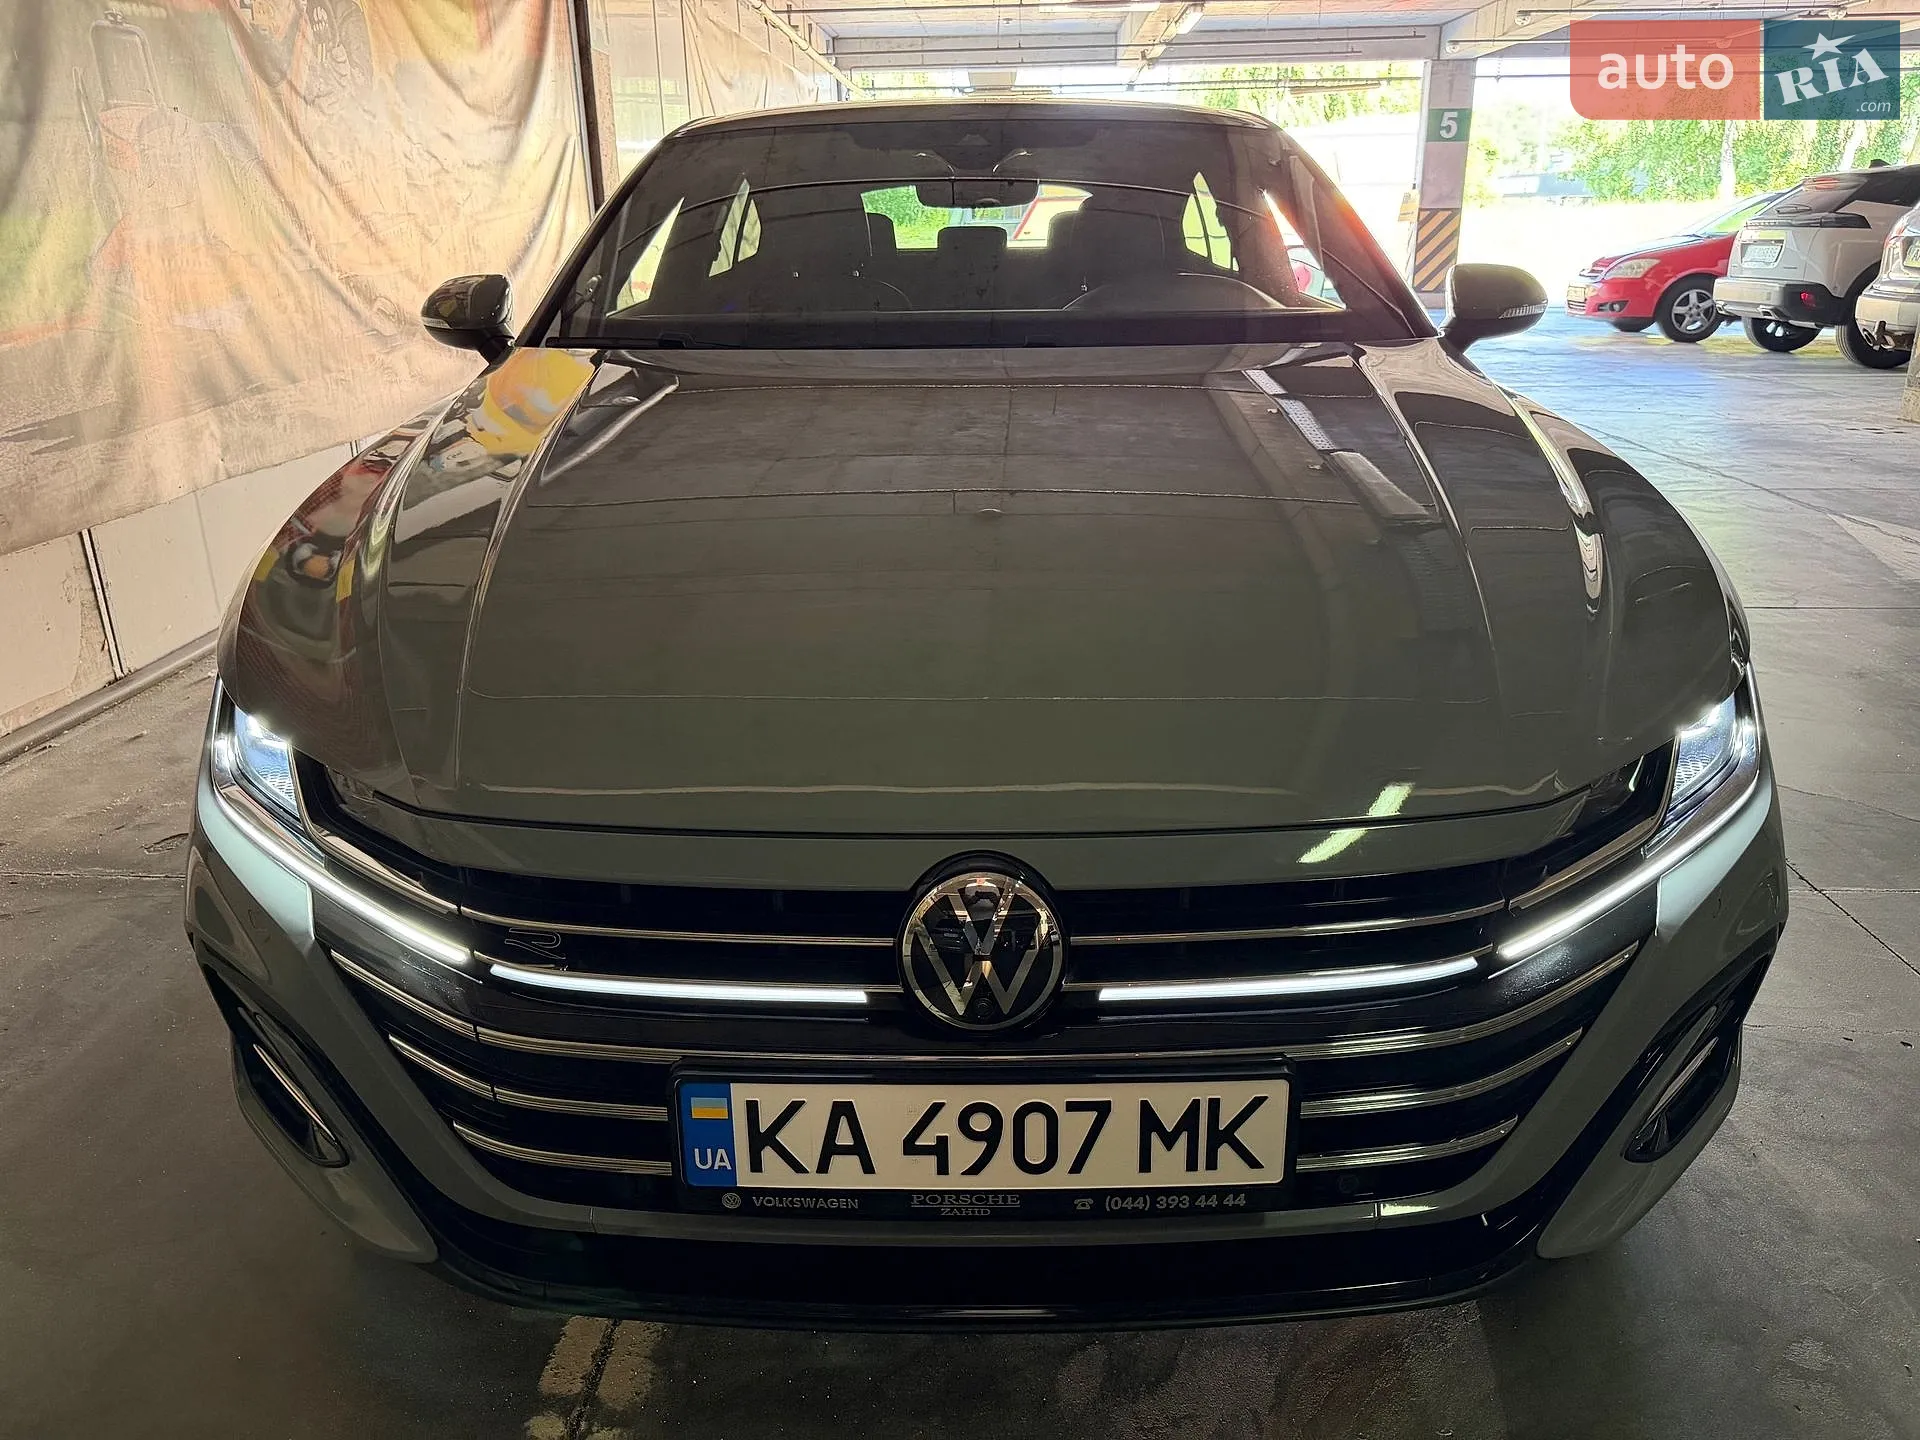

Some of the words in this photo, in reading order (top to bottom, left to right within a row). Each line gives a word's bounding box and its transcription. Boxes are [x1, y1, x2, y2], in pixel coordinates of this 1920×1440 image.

[1440, 111, 1459, 139] 5
[744, 1098, 877, 1175] KA
[901, 1100, 1113, 1176] 4907
[1137, 1095, 1271, 1175] MK
[694, 1147, 733, 1171] UA
[751, 1195, 859, 1210] VOLKSWAGEN
[911, 1193, 1021, 1205] PORSCHE
[1104, 1194, 1151, 1211] (044)
[1155, 1195, 1190, 1209] 393
[1194, 1193, 1218, 1208] 44
[1223, 1193, 1247, 1207] 44
[940, 1207, 992, 1217] ZAHID
